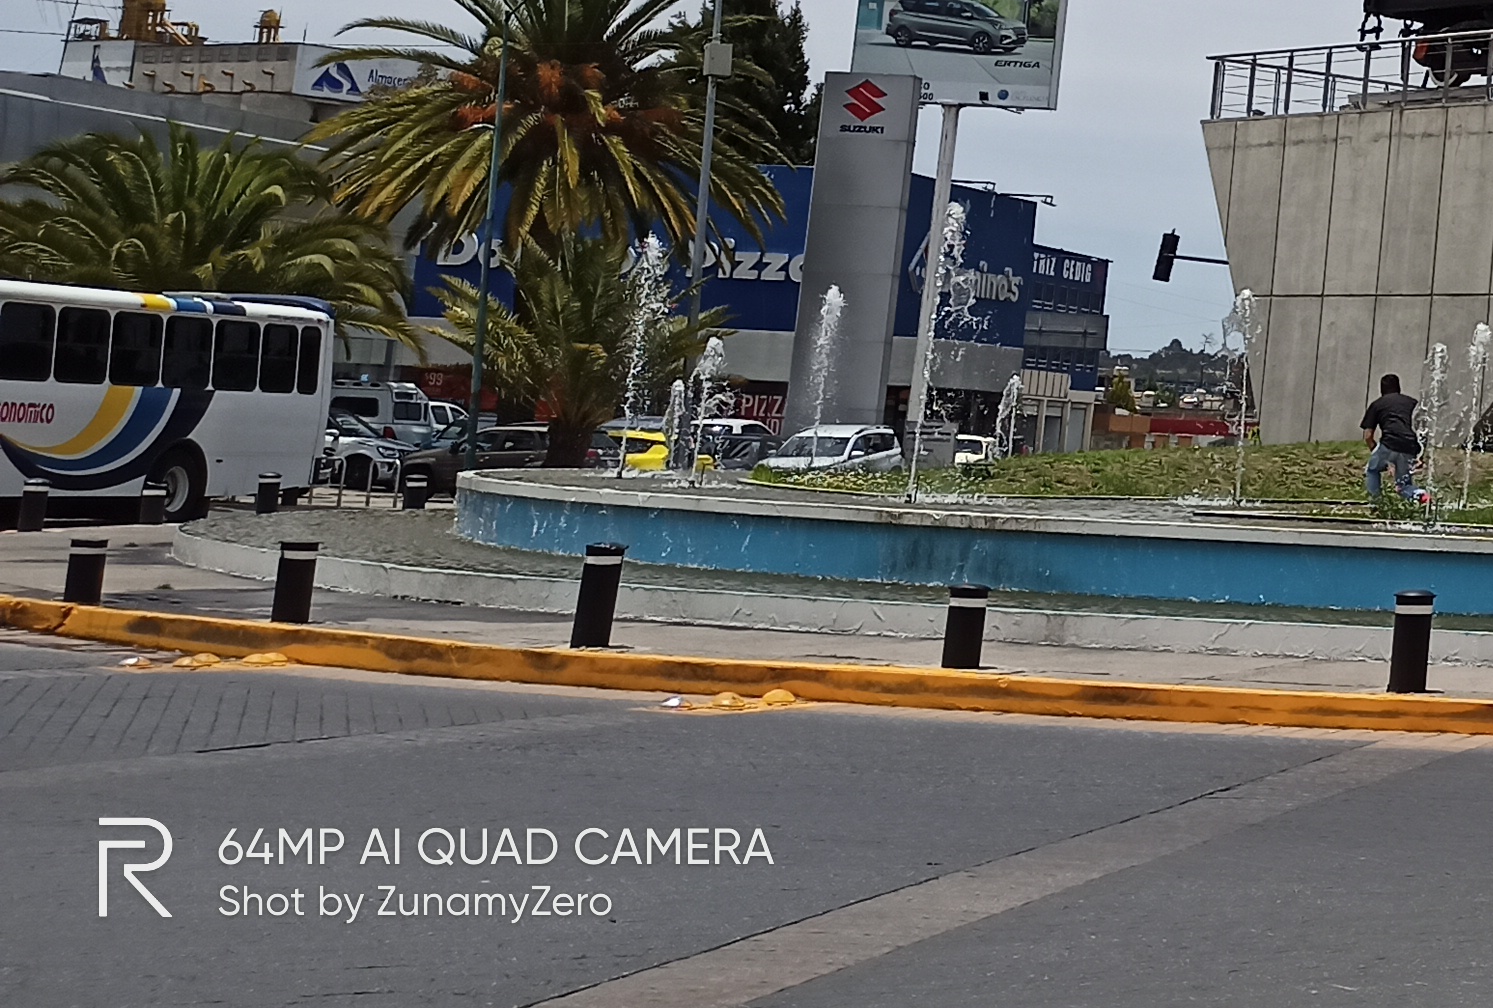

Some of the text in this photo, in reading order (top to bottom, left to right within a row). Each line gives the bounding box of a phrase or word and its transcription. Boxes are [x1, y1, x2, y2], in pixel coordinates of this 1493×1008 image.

[994, 59, 1041, 69] ERTIGA
[839, 124, 885, 135] SUZUKI
[0, 401, 55, 424] onomico
[741, 394, 786, 418] PIZZ
